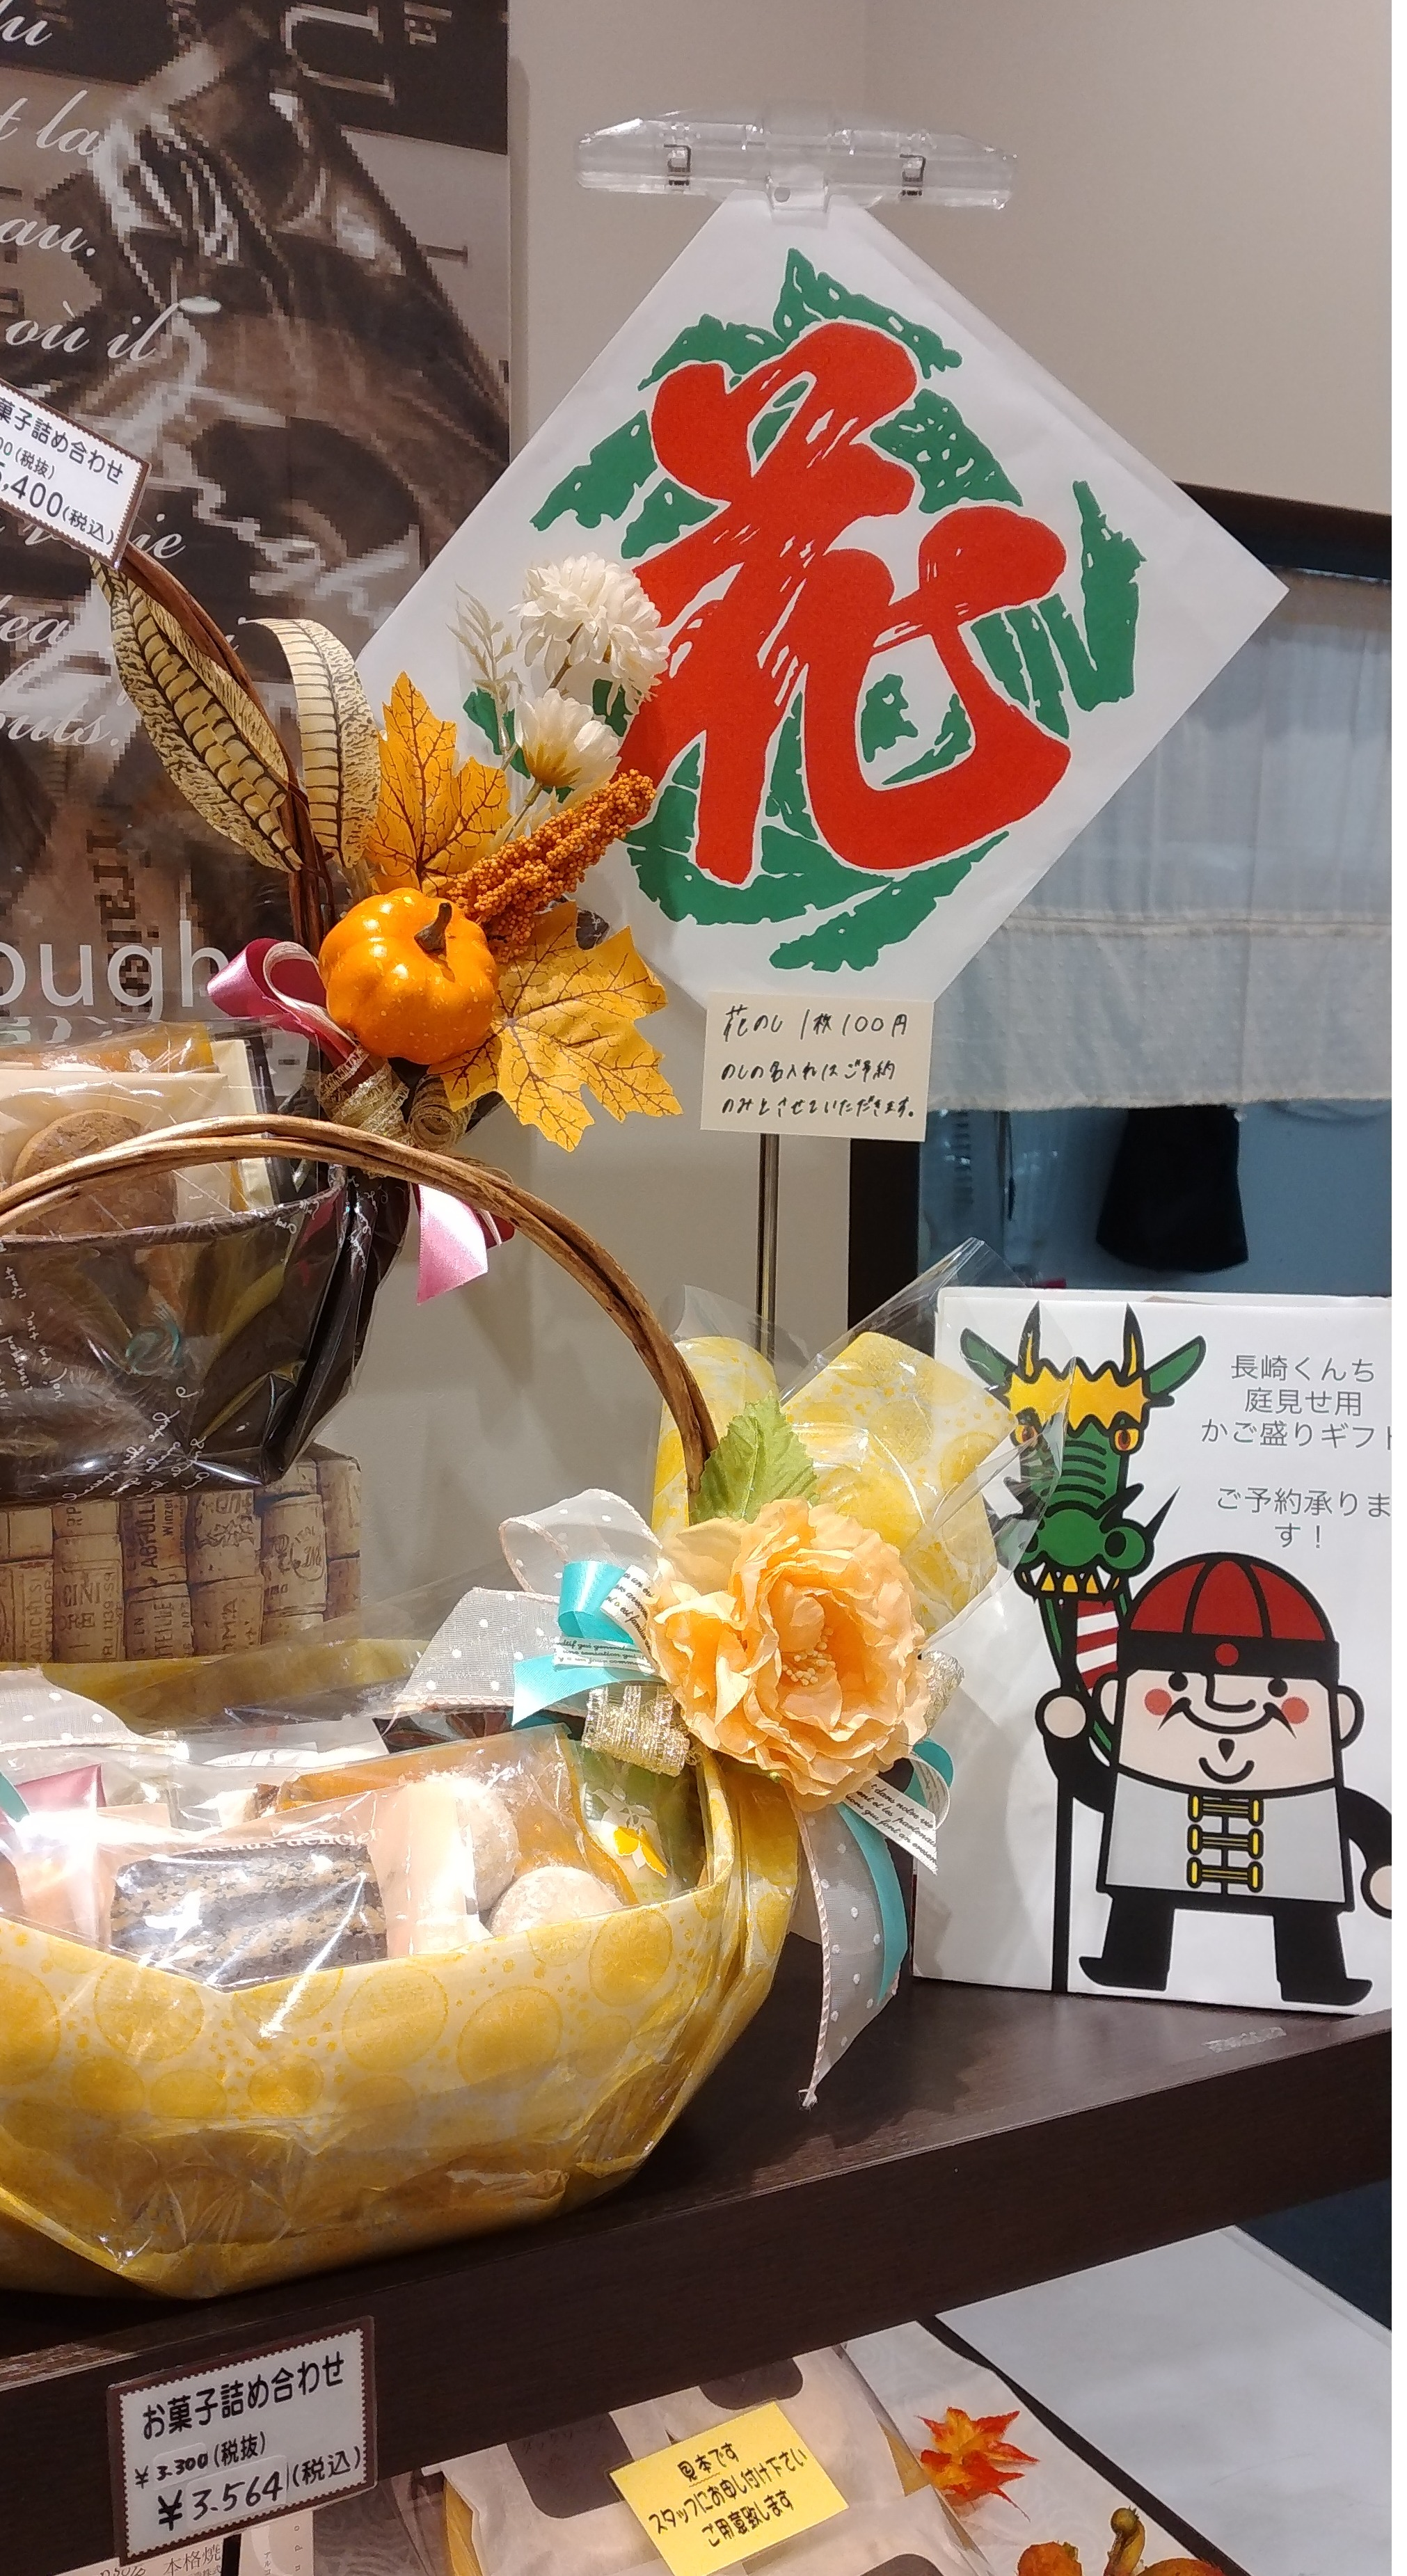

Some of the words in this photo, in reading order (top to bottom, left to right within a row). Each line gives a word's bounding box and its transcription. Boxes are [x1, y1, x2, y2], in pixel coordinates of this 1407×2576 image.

[6, 301, 90, 353] où
[615, 320, 1071, 886] 花
[722, 1004, 784, 1042] 花のし
[842, 1013, 908, 1038] 100円
[1230, 1354, 1375, 1383] 長崎くんち
[1244, 1387, 1362, 1417] 庭見せ用
[1218, 1487, 1391, 1518] ご予約承りま
[142, 2351, 344, 2440] お菓子詰め合わせ
[676, 2442, 740, 2482] 見本です
